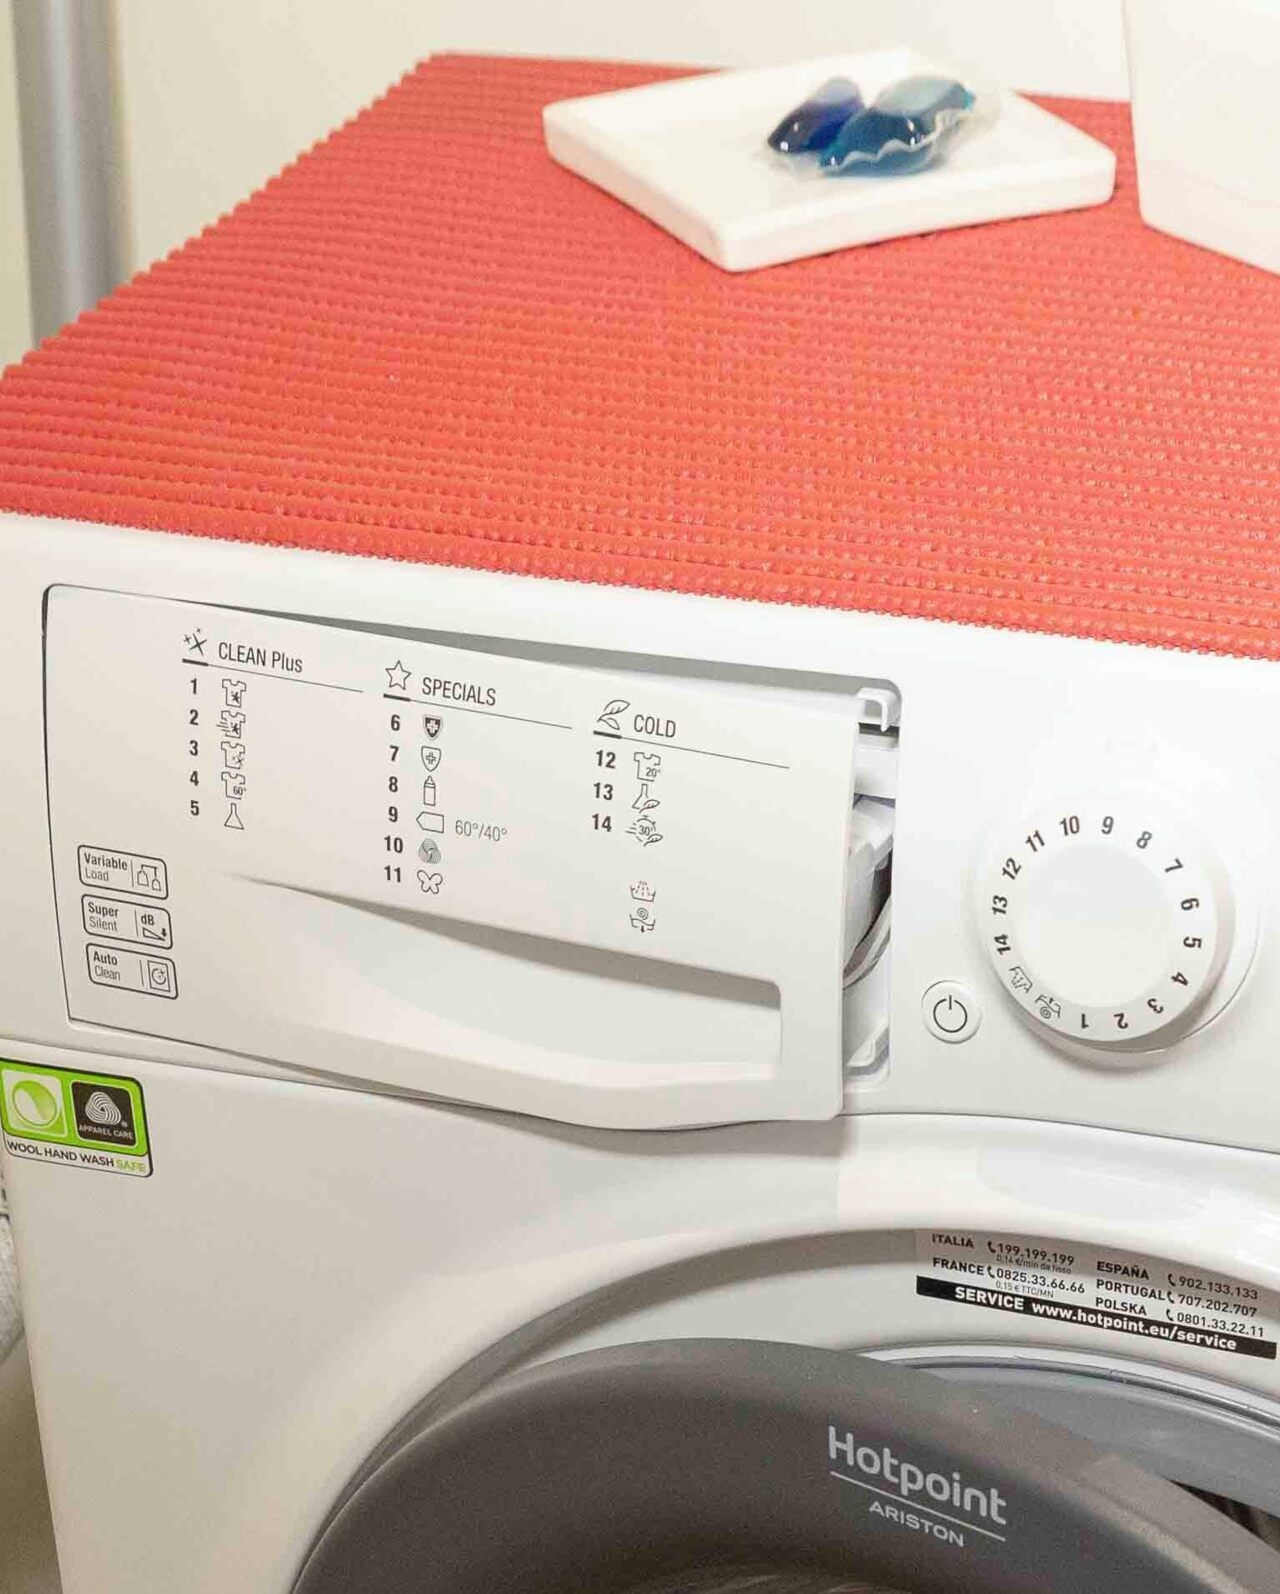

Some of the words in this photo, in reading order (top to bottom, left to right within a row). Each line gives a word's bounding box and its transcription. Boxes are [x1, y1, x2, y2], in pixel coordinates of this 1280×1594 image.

[218, 641, 266, 666] CLEAN
[272, 650, 303, 673] Plus
[190, 678, 197, 694] 1
[422, 677, 496, 706] SPECIALS
[189, 709, 199, 726] 2
[391, 714, 401, 731] 6
[634, 714, 676, 738] COLD
[189, 740, 199, 756] 3
[389, 745, 399, 762] 7
[596, 750, 616, 769] 12
[189, 770, 199, 786] 4
[388, 776, 398, 793] 8
[593, 782, 613, 801] 13
[190, 800, 200, 816] 5
[388, 806, 398, 822] 9
[592, 813, 612, 832] 14
[1059, 816, 1080, 836] 10
[1101, 816, 1114, 835] 9
[384, 835, 404, 854] 10
[1025, 830, 1047, 852] 11
[1136, 831, 1153, 850] 8
[84, 852, 128, 871] Variable
[1001, 858, 1023, 881] 12
[1164, 858, 1183, 875] 7
[85, 867, 109, 882] Load
[384, 865, 401, 883] 11
[88, 901, 119, 918] Super
[992, 895, 1008, 917] 13
[1180, 897, 1199, 912] 6
[89, 916, 118, 932] Silent
[141, 913, 155, 926] dB
[994, 933, 1011, 955] 14
[1183, 936, 1202, 950] 5
[93, 950, 117, 966] Auto
[94, 965, 121, 981] Clean
[1171, 970, 1189, 987] 4
[1147, 998, 1164, 1015] 3
[1079, 1014, 1089, 1029] 1
[1113, 1013, 1129, 1030] 2
[79, 1124, 112, 1137] APPAREL
[113, 1129, 134, 1141] CARE
[6, 1139, 42, 1156] WOOL
[44, 1148, 78, 1162] HAND
[79, 1153, 114, 1167] WASH
[116, 1159, 147, 1173] SAFE
[932, 1233, 975, 1249] ITALIA
[997, 1243, 1075, 1267] 199.199.199
[932, 1257, 985, 1276] FRANCE
[996, 1268, 1085, 1294] 0825.33.66.66
[1097, 1260, 1149, 1281] ESPAÑA
[1179, 1276, 1259, 1300] 902.133.133
[1096, 1279, 1165, 1301] PORTUGAL
[1178, 1294, 1258, 1318] 707.202.707
[955, 1286, 1025, 1311] SERVICE
[1032, 1301, 1238, 1350] www.hotpoint.eu/service
[1096, 1297, 1147, 1316] POLSKA
[1177, 1312, 1264, 1338] 0801.33.22.11
[828, 1425, 1007, 1525] Hotpoint
[869, 1501, 964, 1547] ARISTON
